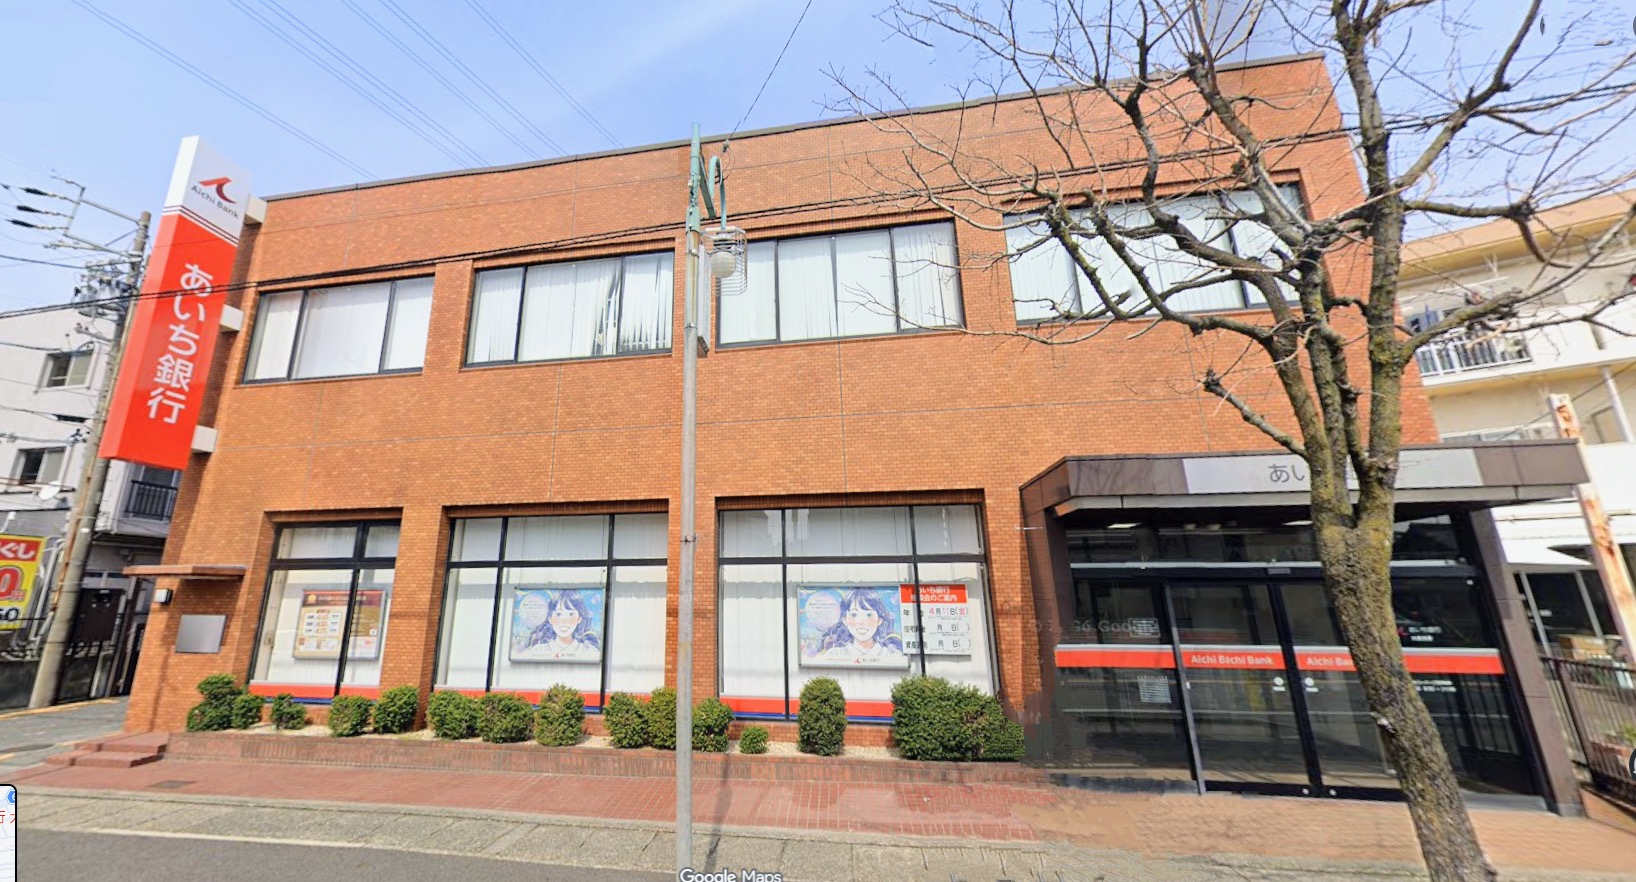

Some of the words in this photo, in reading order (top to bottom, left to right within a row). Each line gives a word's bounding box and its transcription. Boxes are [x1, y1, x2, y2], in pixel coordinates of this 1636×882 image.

[191, 185, 215, 204] Aichi
[217, 200, 239, 219] Bank
[147, 263, 214, 424] あいち銀行
[1191, 655, 1216, 664] Aichi
[1247, 656, 1274, 665] Bank
